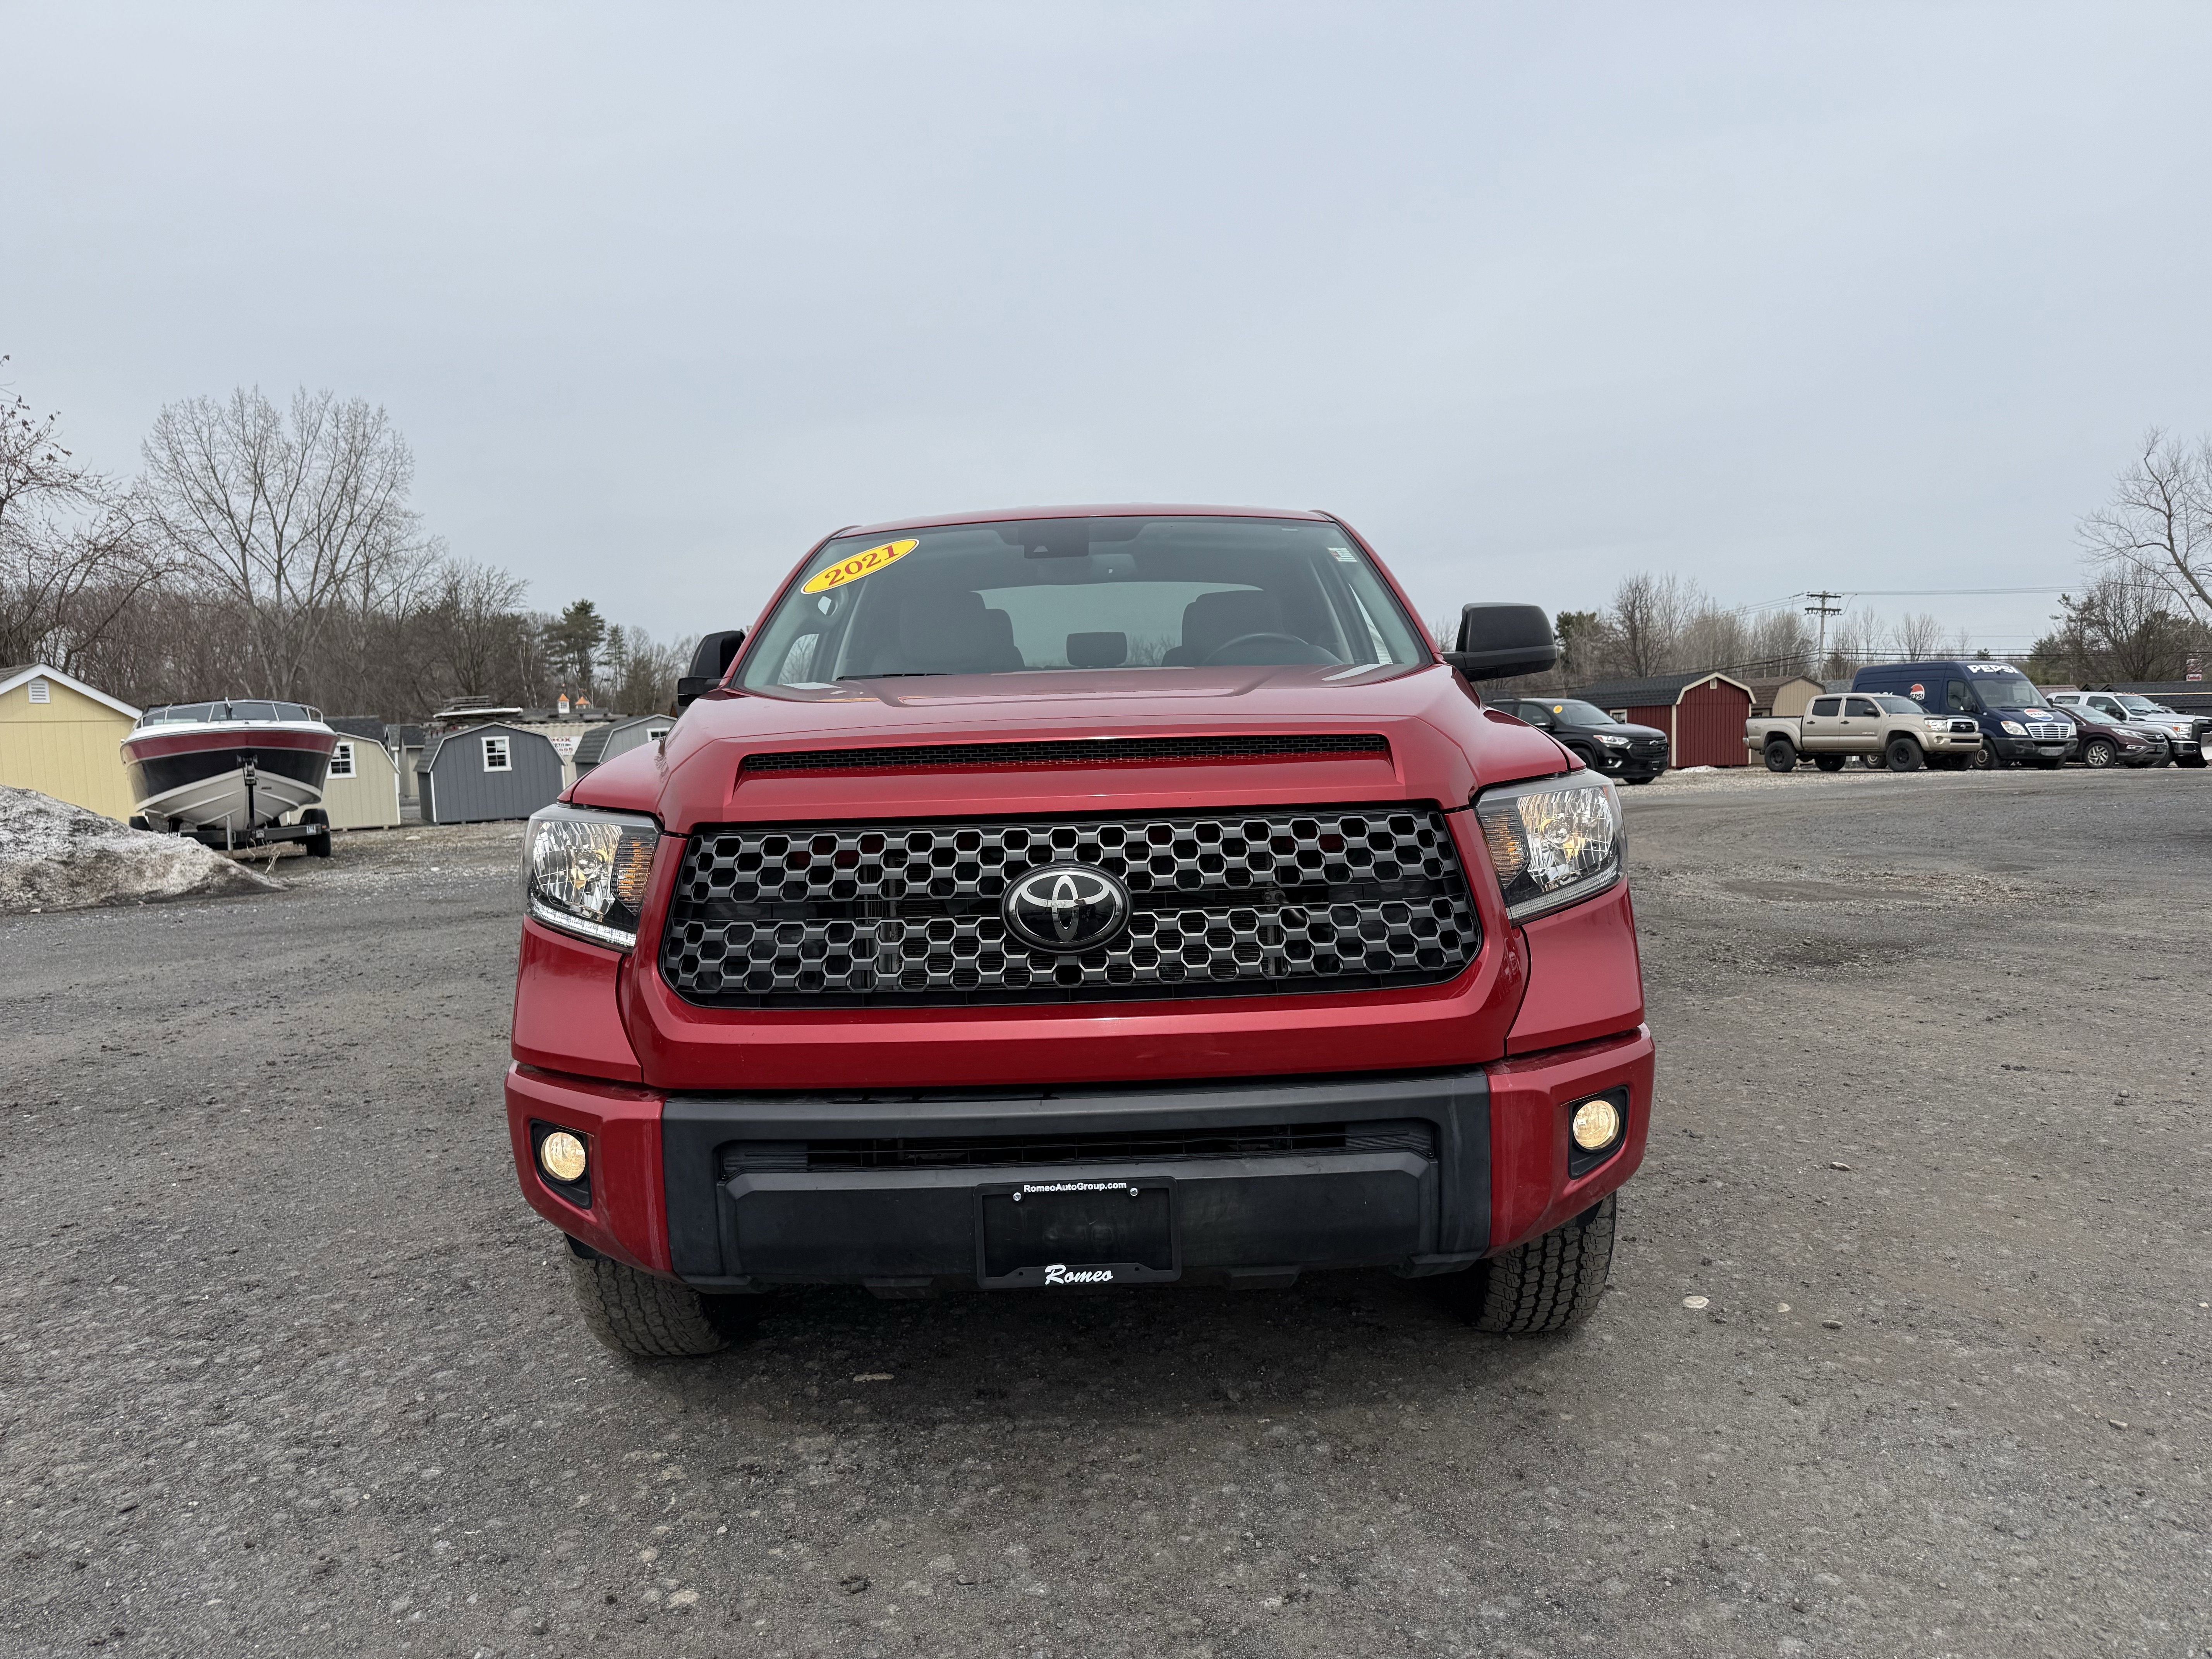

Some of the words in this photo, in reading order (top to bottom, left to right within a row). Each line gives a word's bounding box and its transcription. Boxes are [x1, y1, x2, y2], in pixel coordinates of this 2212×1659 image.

[824, 545, 899, 586] 2021
[1967, 665, 2019, 674] PEPSI
[1024, 1182, 1127, 1193] RomeoAutoGroup.com
[1044, 1264, 1113, 1285] Romeo
